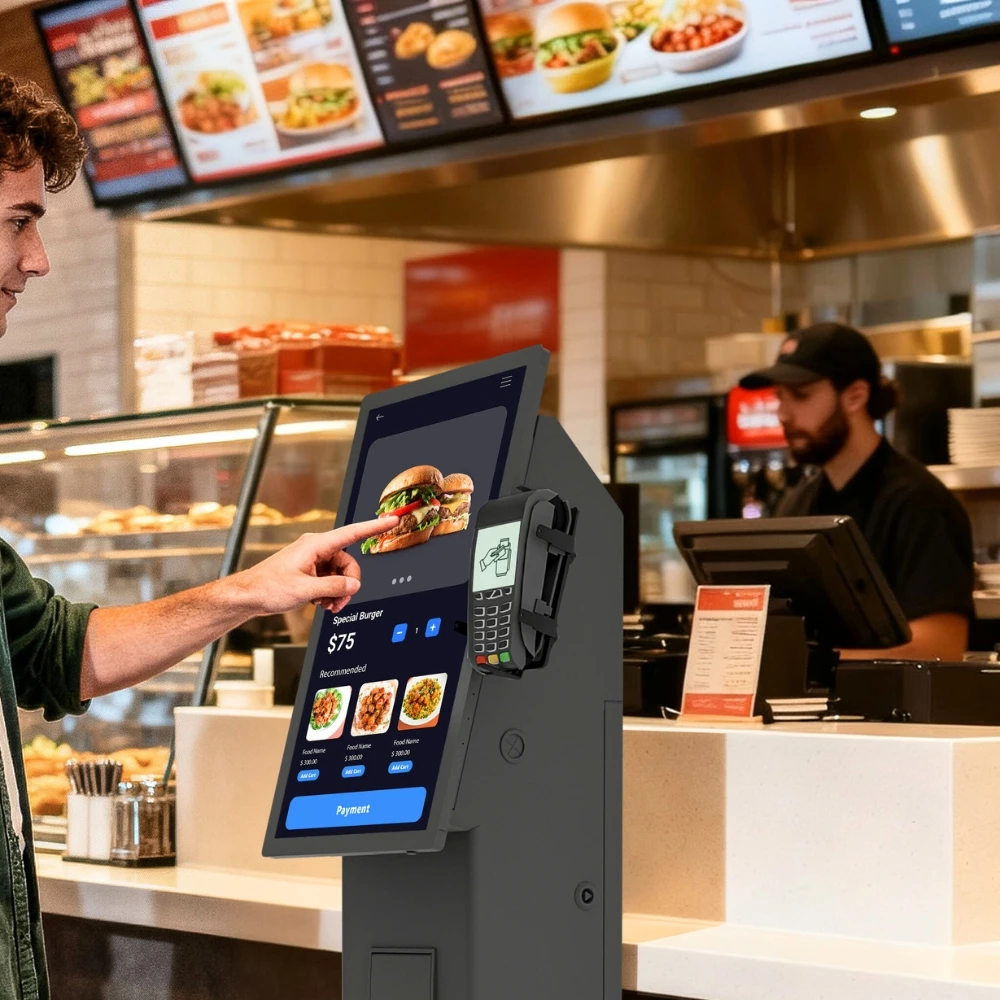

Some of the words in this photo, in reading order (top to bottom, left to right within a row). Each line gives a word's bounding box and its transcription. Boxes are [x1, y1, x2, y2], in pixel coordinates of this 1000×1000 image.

[332, 612, 359, 626] Special
[359, 609, 384, 621] Burger
[327, 632, 356, 654] $75
[319, 664, 368, 678] Recommended
[336, 804, 371, 817] Payment
